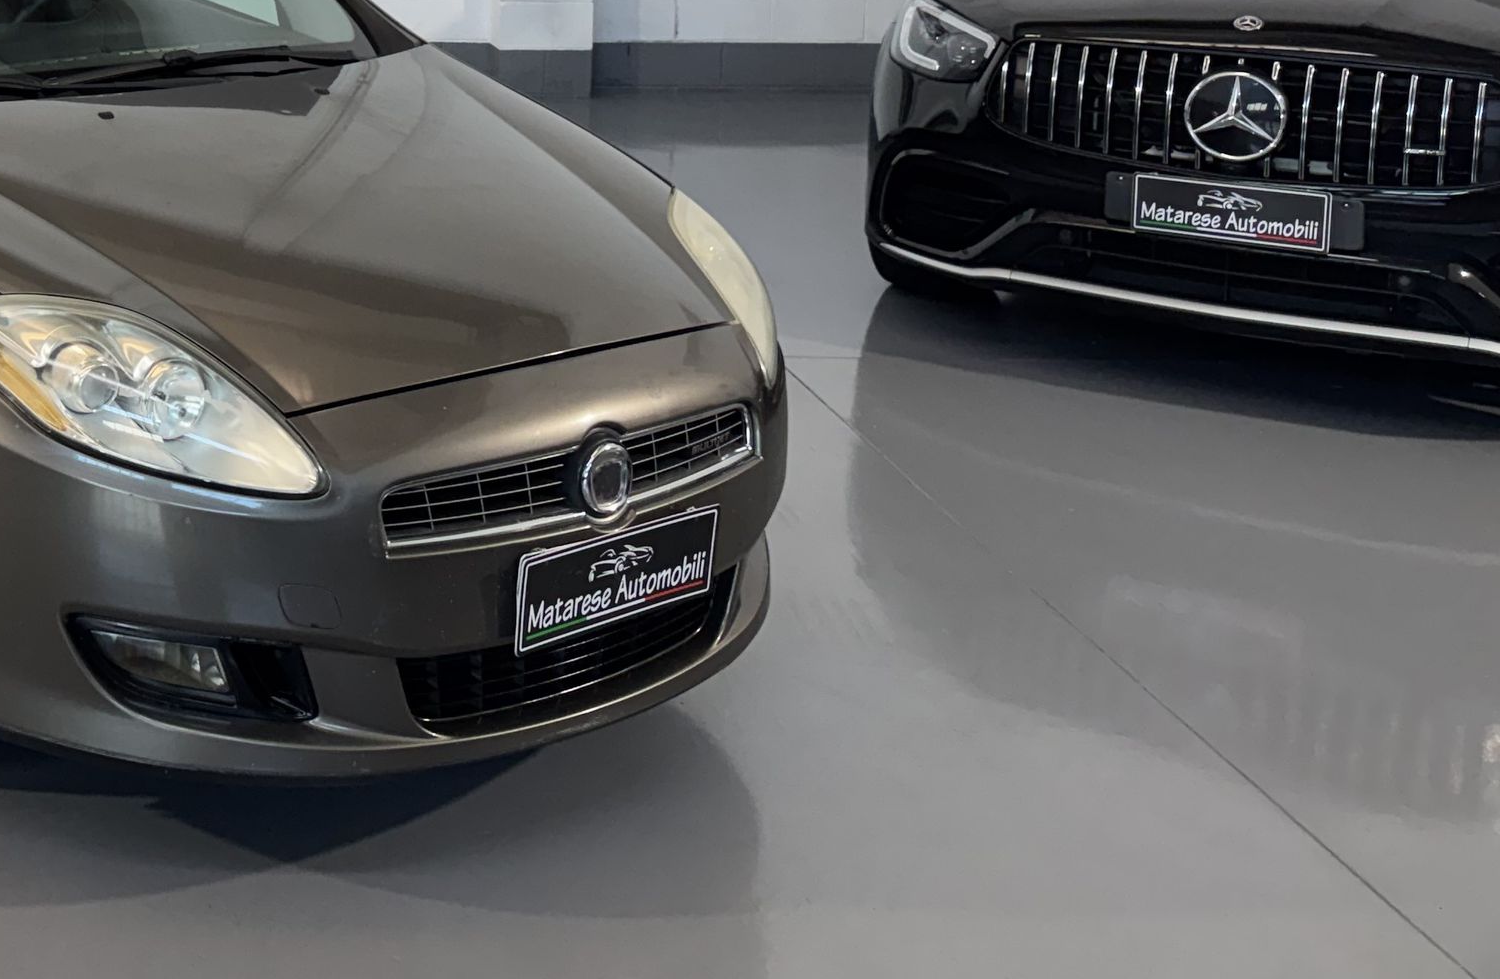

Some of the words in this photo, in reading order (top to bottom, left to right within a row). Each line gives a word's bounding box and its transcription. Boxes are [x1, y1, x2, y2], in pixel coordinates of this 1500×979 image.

[1140, 201, 1221, 229] Matarese
[1225, 211, 1319, 241] Automobili
[527, 587, 611, 633] Matarese
[614, 551, 707, 604] Automobili
